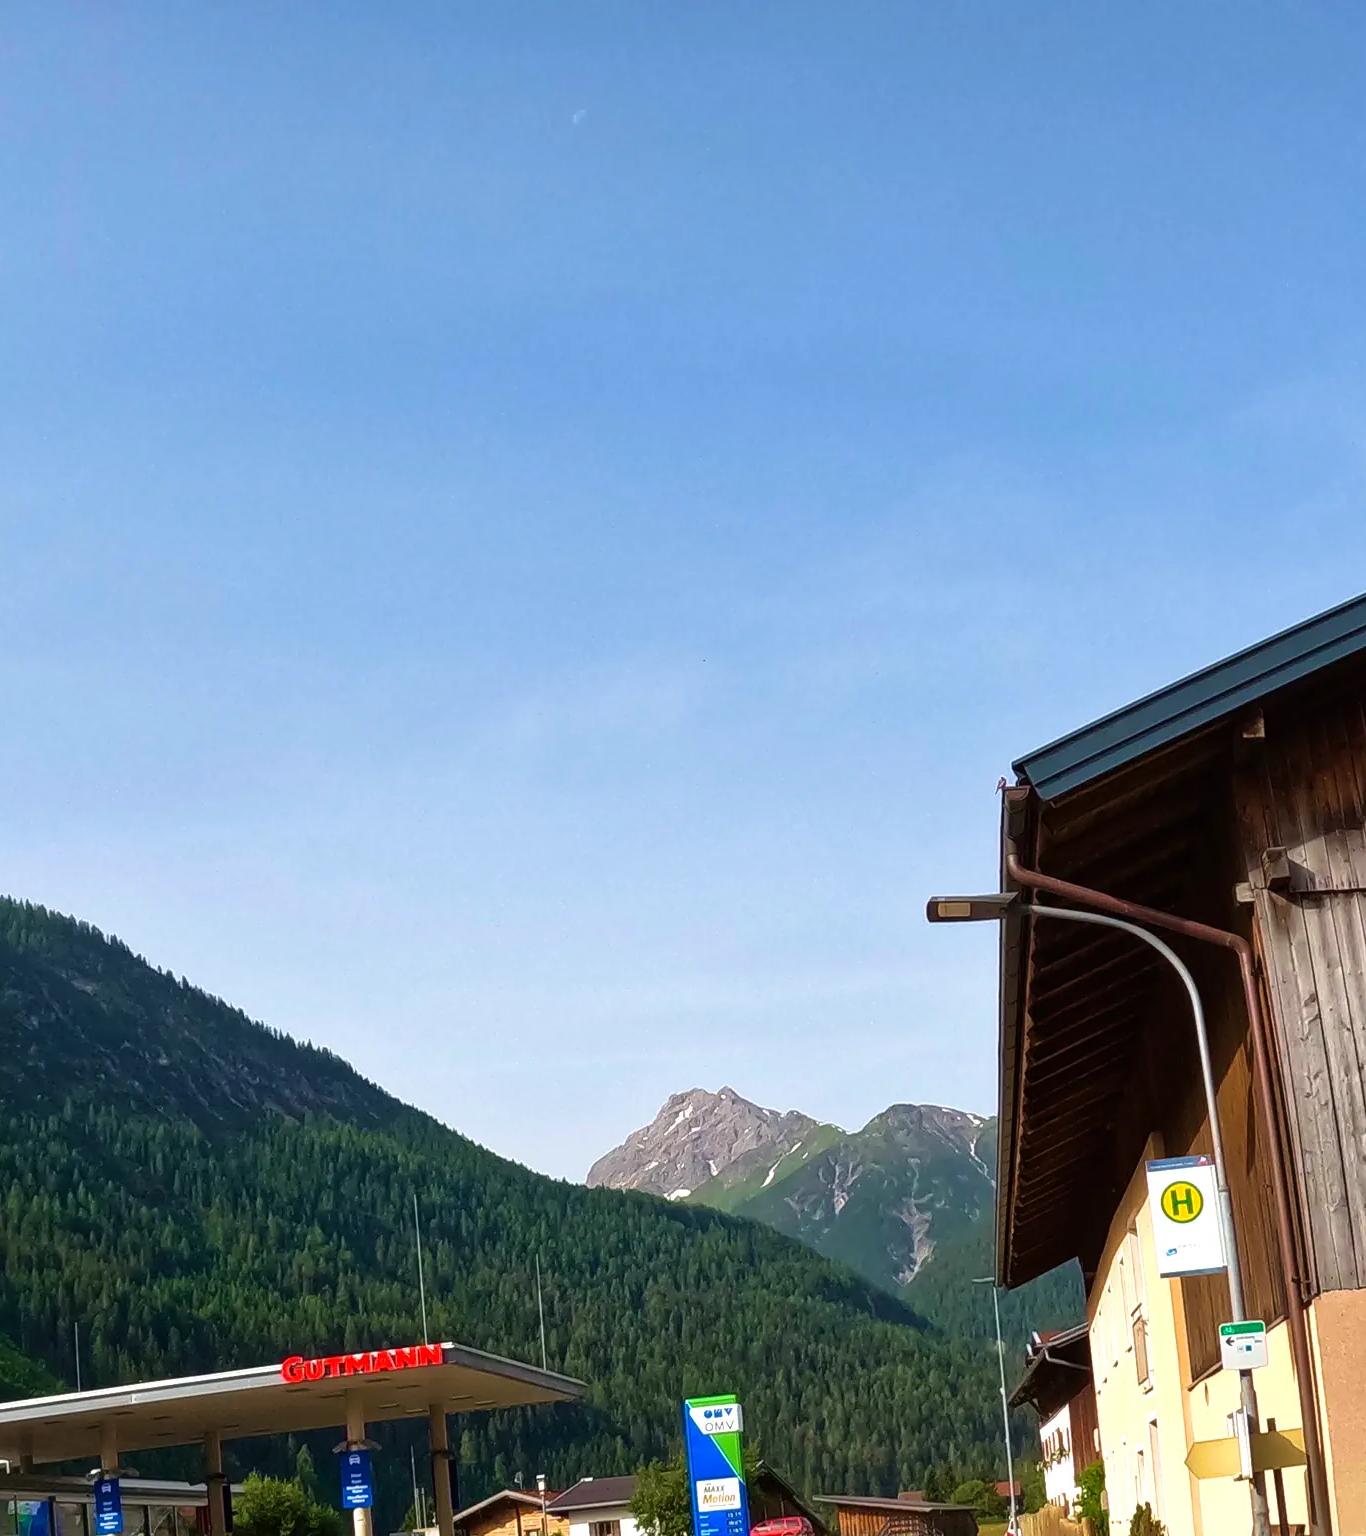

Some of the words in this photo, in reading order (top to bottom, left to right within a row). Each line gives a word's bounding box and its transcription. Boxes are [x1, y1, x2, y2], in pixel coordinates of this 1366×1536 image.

[1170, 1188, 1194, 1216] H
[281, 1343, 443, 1384] GUTMANN
[704, 1420, 735, 1432] OMV
[703, 1485, 726, 1494] MAXX
[702, 1493, 736, 1505] Motion
